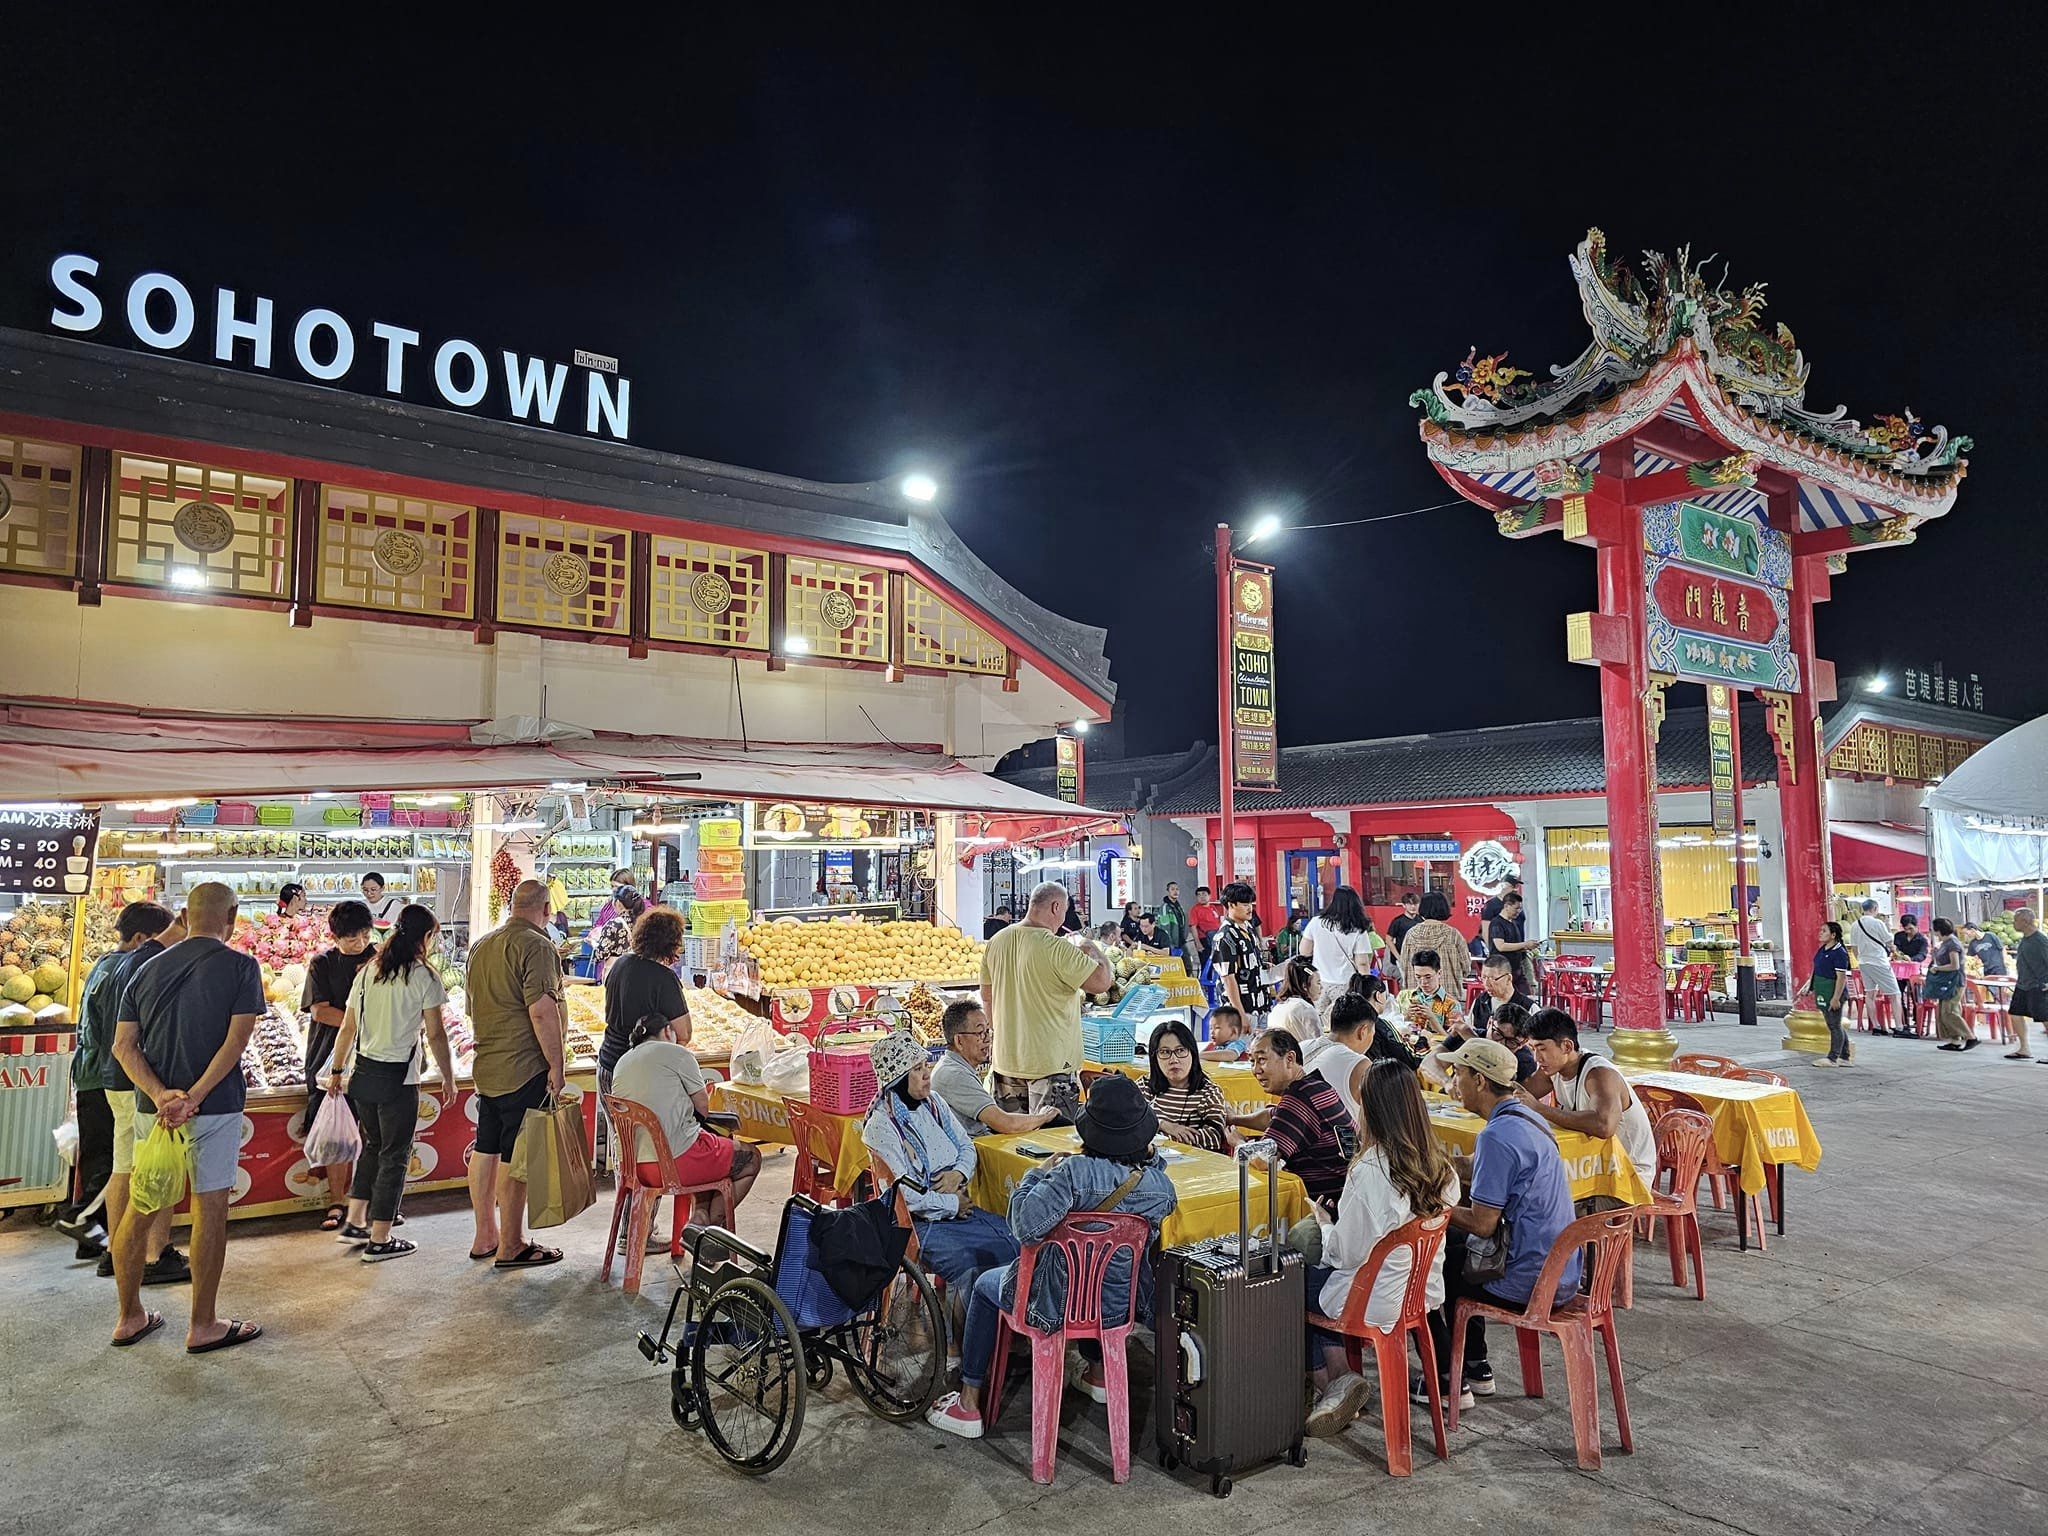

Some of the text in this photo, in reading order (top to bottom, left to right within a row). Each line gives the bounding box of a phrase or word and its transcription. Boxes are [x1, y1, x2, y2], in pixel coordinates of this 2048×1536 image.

[51, 254, 630, 440] SOHOTOWN
[1239, 652, 1268, 674] SOHO
[1240, 686, 1269, 706] TOWN
[1905, 668, 1984, 711] 芭堤雅唐人街
[0, 811, 95, 830] AM 冰淇淋
[0, 838, 11, 851] S
[37, 840, 60, 852] 20
[34, 857, 57, 870] 40
[32, 876, 56, 888] 60
[740, 1095, 790, 1129] SING
